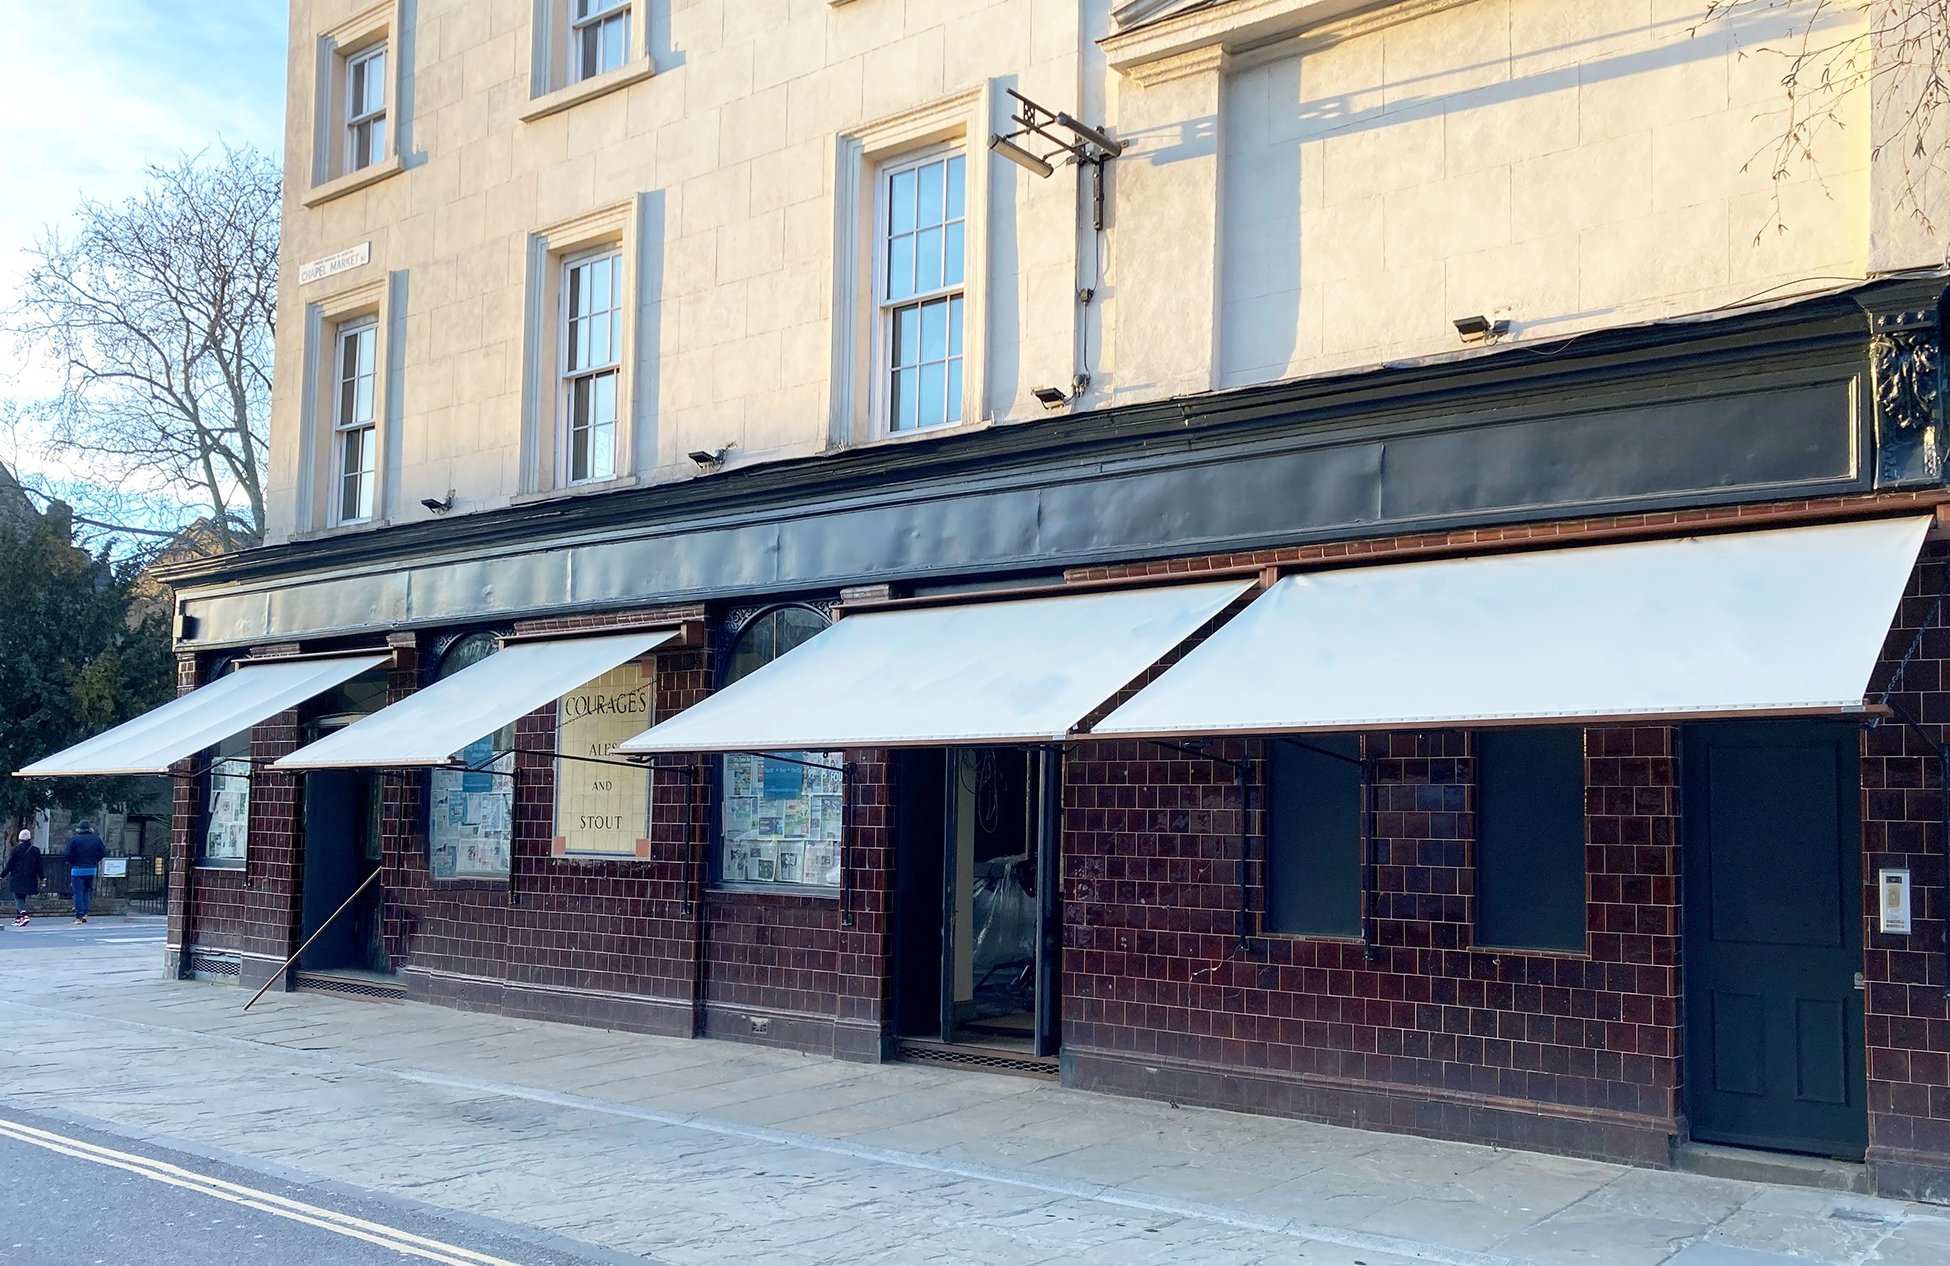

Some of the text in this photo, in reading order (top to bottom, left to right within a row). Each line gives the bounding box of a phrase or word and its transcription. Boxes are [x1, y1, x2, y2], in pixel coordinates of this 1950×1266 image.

[302, 265, 327, 282] CHAPEL
[330, 253, 360, 273] MARKET
[592, 780, 613, 792] AND
[580, 815, 623, 830] STOUT
